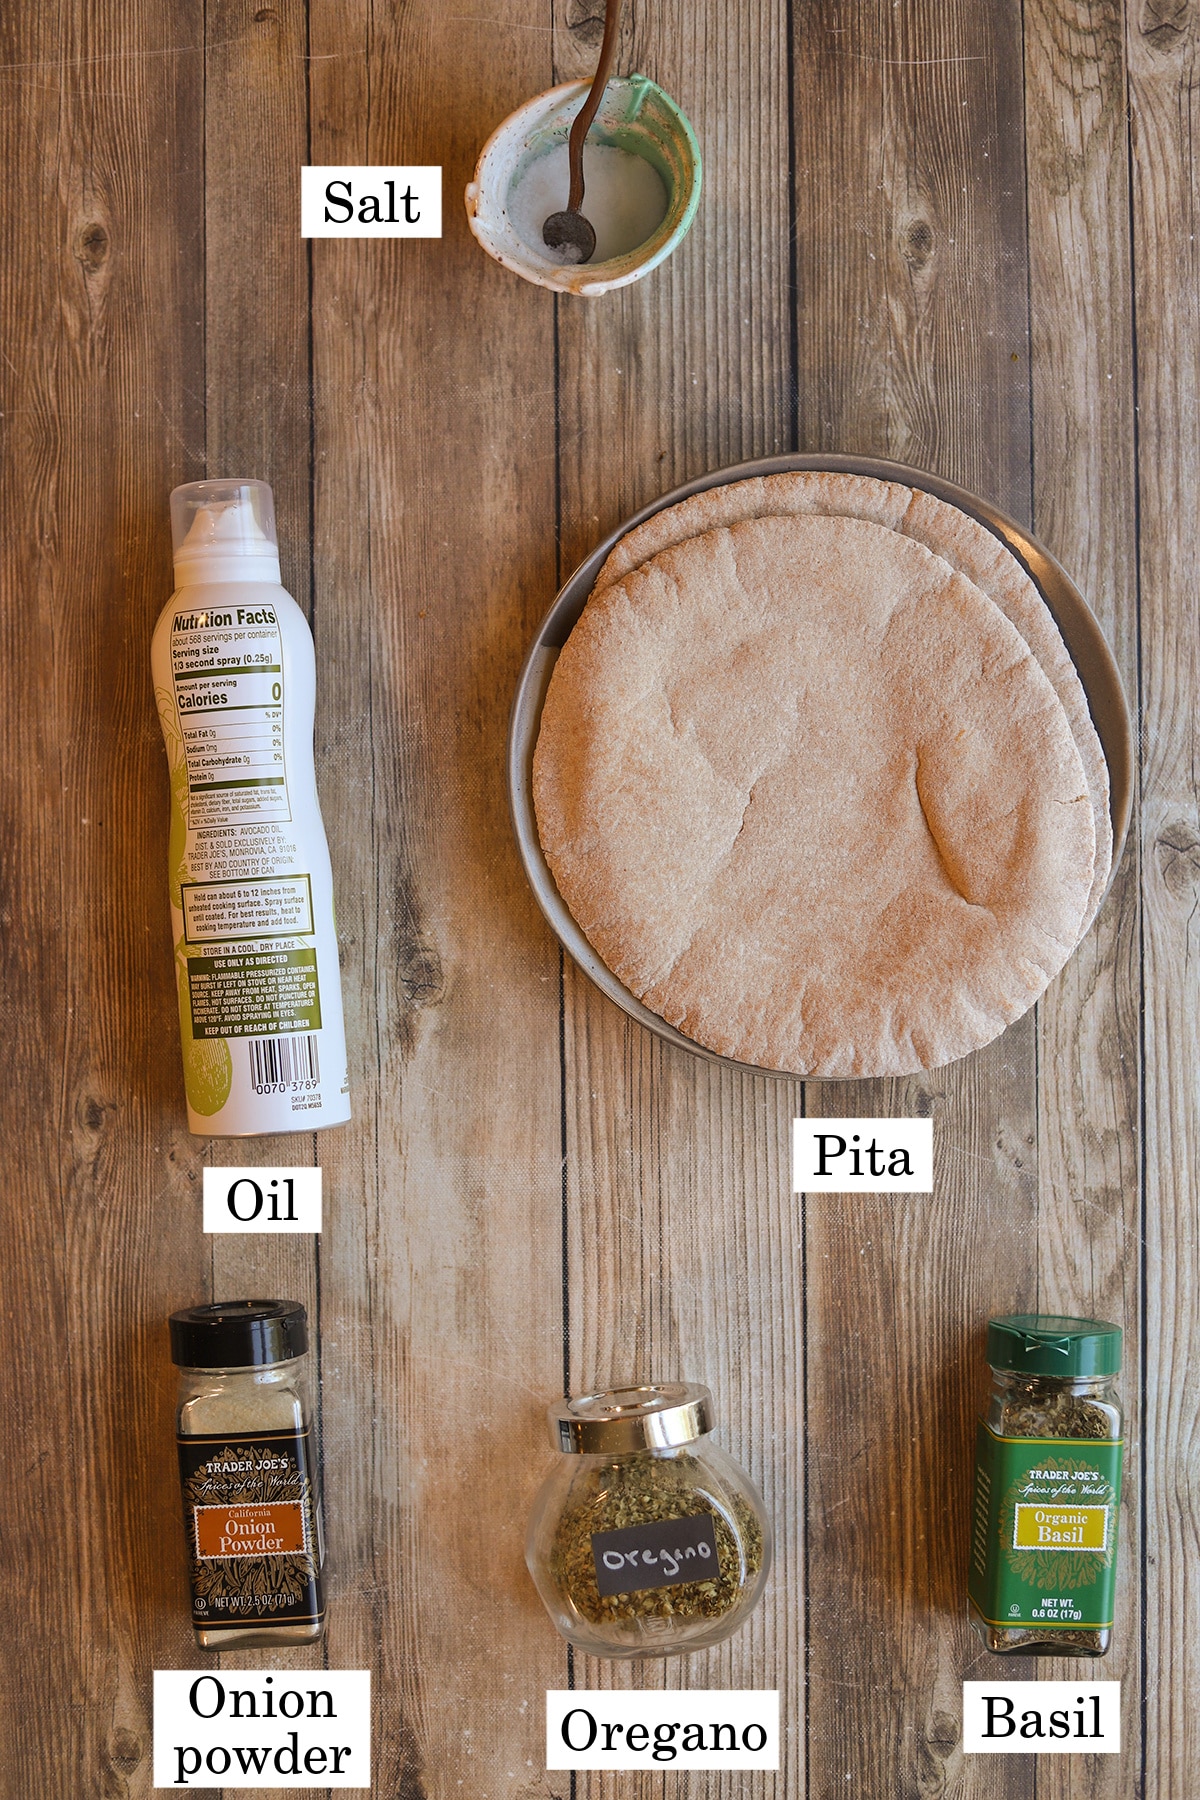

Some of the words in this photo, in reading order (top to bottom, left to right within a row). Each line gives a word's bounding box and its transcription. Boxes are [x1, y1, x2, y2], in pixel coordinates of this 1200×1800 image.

[174, 611, 232, 632] Nutrition
[237, 609, 275, 625] Facts
[173, 637, 188, 647] about
[190, 635, 201, 644] 568
[203, 632, 232, 643] servings
[235, 632, 246, 641] per
[248, 630, 277, 639] container
[173, 648, 199, 659] Serving
[203, 646, 219, 654] size
[174, 661, 183, 670] 1/3
[186, 657, 214, 668] second
[217, 657, 240, 666] spray
[244, 653, 272, 665] (0.25g)
[176, 682, 198, 692] Amount
[199, 682, 209, 690] per
[211, 680, 237, 688] serving
[178, 692, 228, 708] Calories
[272, 682, 281, 701] 0
[199, 730, 208, 738] Fat
[187, 745, 205, 754] Sodium
[188, 760, 200, 768] Total
[202, 757, 241, 767] Carbohydrate
[190, 773, 207, 781] Protein
[197, 830, 237, 839] INGREDIENTS:
[240, 827, 270, 835] AVOCADO
[216, 841, 232, 849] SOLD
[234, 837, 275, 847] EXCLUSIVELY
[188, 852, 208, 860] TRADER
[191, 864, 203, 872] BEST
[214, 861, 227, 869] AND
[229, 859, 259, 868] COUNTRY
[210, 871, 221, 879] SEE
[222, 868, 250, 878] BOTTOM
[219, 891, 236, 899] about
[252, 889, 258, 897] 12
[261, 887, 281, 895] inches
[213, 902, 236, 911] cooking
[237, 900, 263, 909] surface.
[265, 898, 282, 907] Spray
[284, 897, 304, 905] surface
[228, 911, 238, 919] For
[240, 910, 254, 918] best
[281, 907, 293, 915] heat
[196, 924, 216, 932] cooking
[218, 920, 255, 930] temperature
[203, 947, 222, 956] STORE
[276, 941, 295, 949] PLACE
[214, 960, 226, 968] USE
[228, 958, 243, 967] ONLY
[256, 955, 288, 964] DIRECTED
[212, 972, 244, 980] FLAMMABLE
[246, 968, 286, 978] PRESSURIZED
[266, 994, 278, 1002] NOT
[279, 992, 307, 1001] PUNCTURE
[243, 1004, 262, 1012] STORE
[272, 999, 314, 1009] TEMPERATURES
[242, 1011, 271, 1020] SPRAYING
[205, 1027, 218, 1035] KEEP
[221, 1026, 233, 1034] OUT
[244, 1023, 267, 1032] REACH
[269, 1022, 277, 1030] OF
[279, 1019, 309, 1029] CHILDREN
[257, 1083, 285, 1094] 0070
[292, 1080, 317, 1091] 3789
[206, 1461, 253, 1474] TRADER
[256, 1458, 289, 1470] JOE'S
[1029, 1470, 1069, 1480] TRADER
[1071, 1472, 1099, 1480] JOE'S
[195, 1478, 233, 1496] Spices
[234, 1477, 247, 1494] of
[247, 1478, 263, 1488] the
[267, 1471, 303, 1486] World
[1019, 1483, 1050, 1497] Spices
[1051, 1488, 1061, 1498] of
[1061, 1484, 1076, 1494] the
[1080, 1484, 1109, 1495] World
[229, 1509, 271, 1518] California
[1035, 1511, 1088, 1526] Organic
[225, 1519, 275, 1536] Onion
[1037, 1526, 1083, 1543] Basil
[219, 1535, 283, 1553] Powder
[602, 1541, 711, 1576] Oregano
[215, 1598, 229, 1607] NET
[231, 1596, 246, 1607] WT.
[248, 1596, 260, 1606] 2.5
[263, 1595, 273, 1605] OZ
[275, 1593, 295, 1606] (71g)
[1042, 1598, 1058, 1607] NET
[1060, 1599, 1074, 1607] WT.
[1032, 1609, 1045, 1617] 0.6
[1047, 1609, 1058, 1618] OZ
[1060, 1609, 1082, 1620] (17g)
